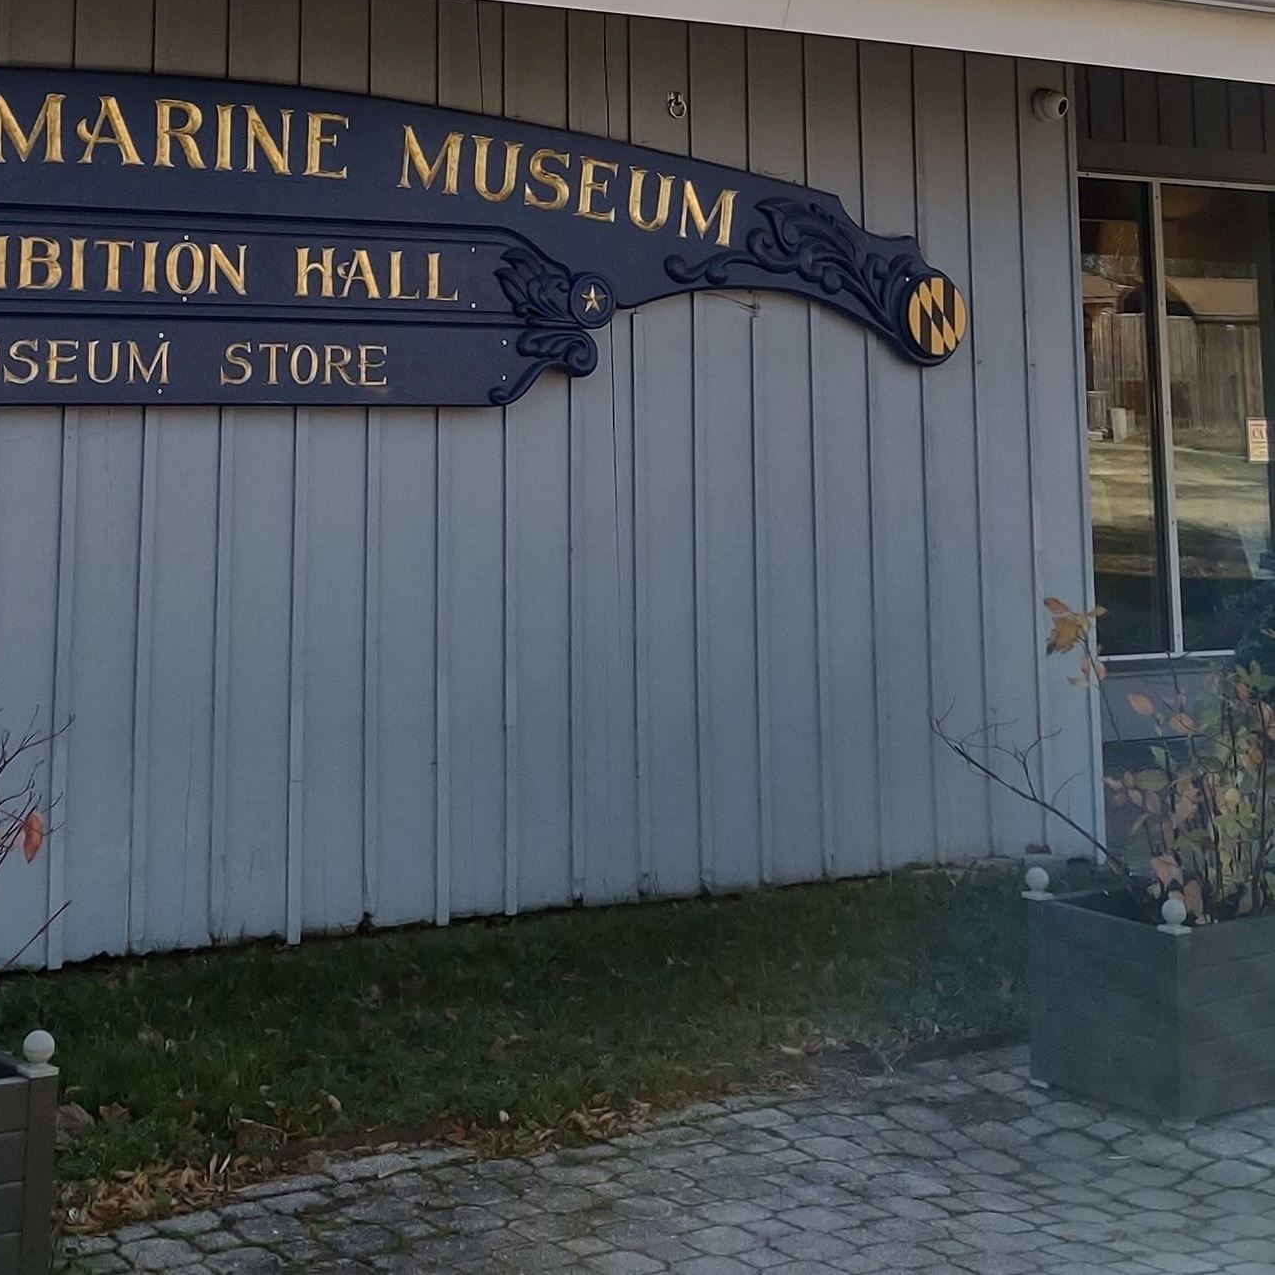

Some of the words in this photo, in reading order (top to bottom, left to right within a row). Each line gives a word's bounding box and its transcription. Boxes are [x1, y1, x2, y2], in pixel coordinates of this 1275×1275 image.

[398, 125, 740, 247] MUSEUM
[295, 247, 459, 302] HALL
[219, 343, 389, 387] STORE
